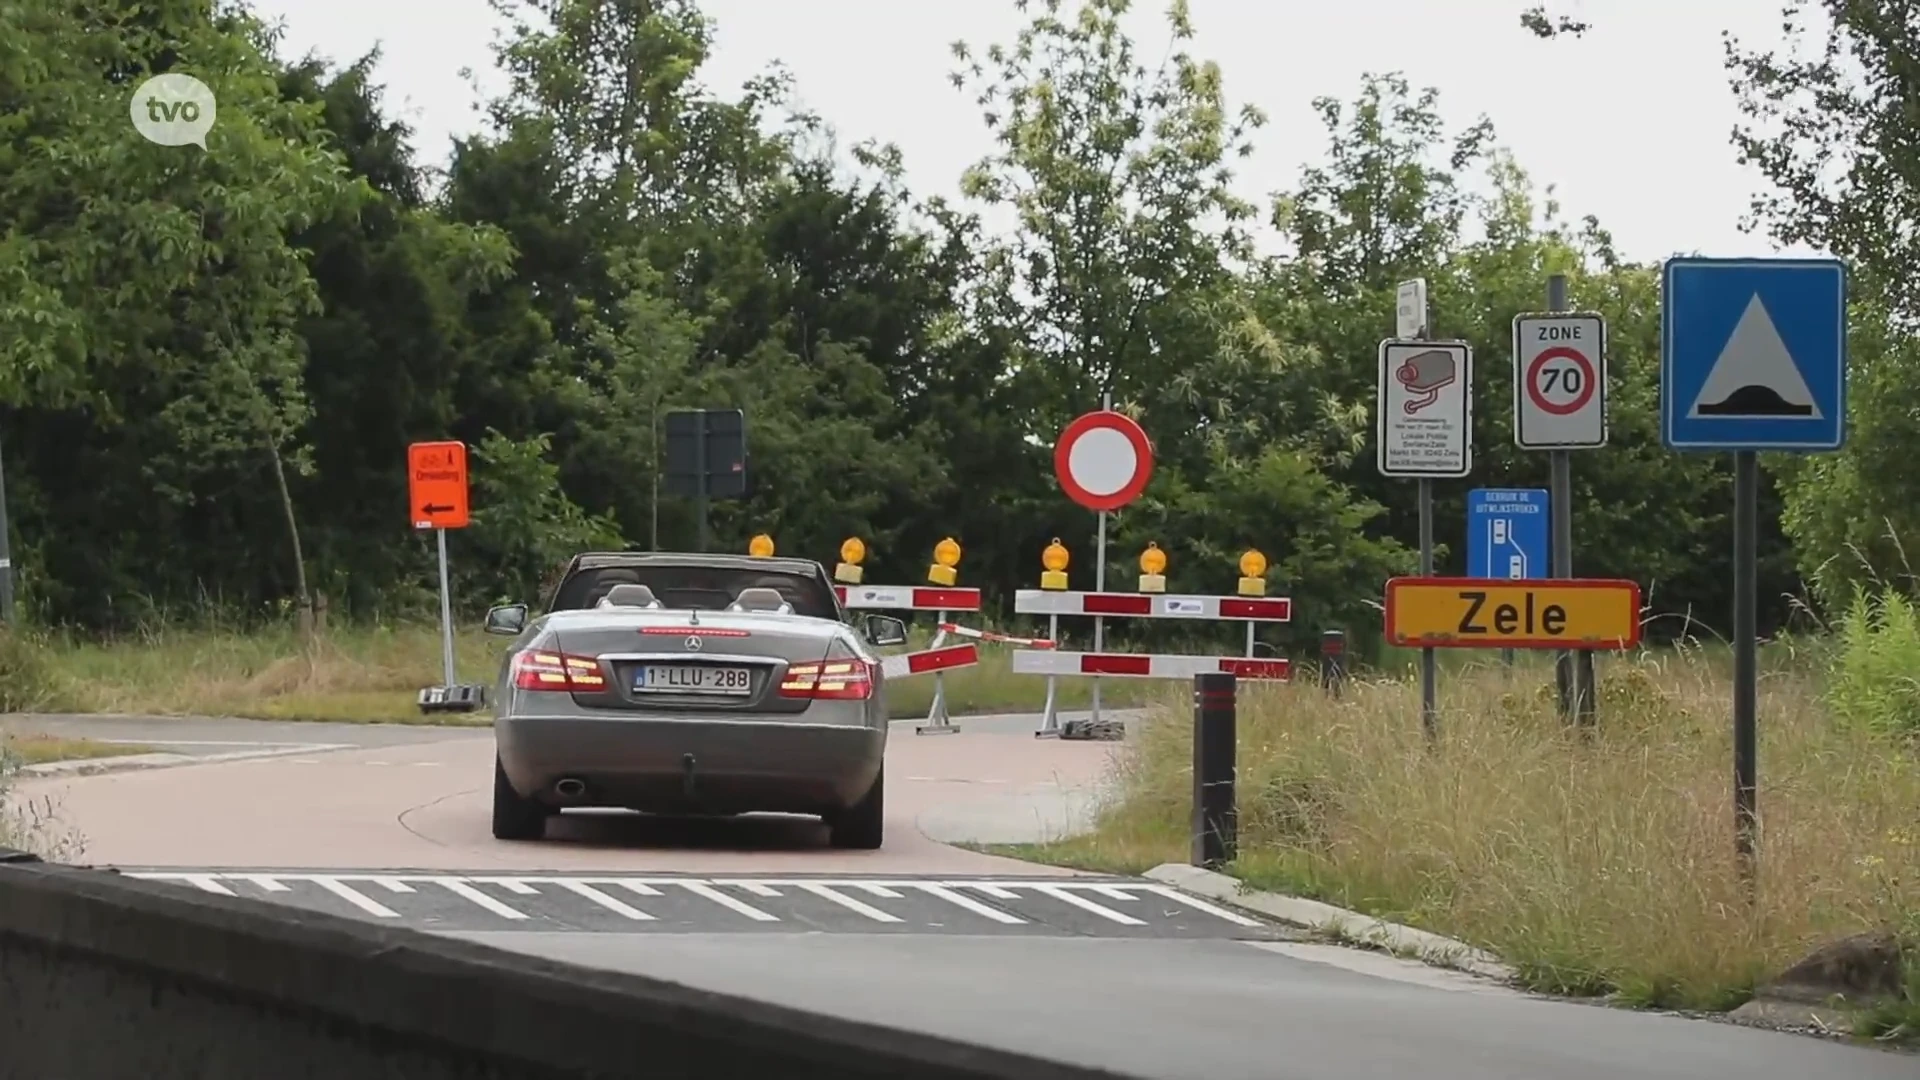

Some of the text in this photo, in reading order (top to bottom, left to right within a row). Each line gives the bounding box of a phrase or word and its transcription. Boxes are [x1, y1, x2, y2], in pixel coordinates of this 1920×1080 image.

[1538, 326, 1582, 341] ZONE
[1542, 367, 1581, 394] 70
[1458, 591, 1567, 635] Zele
